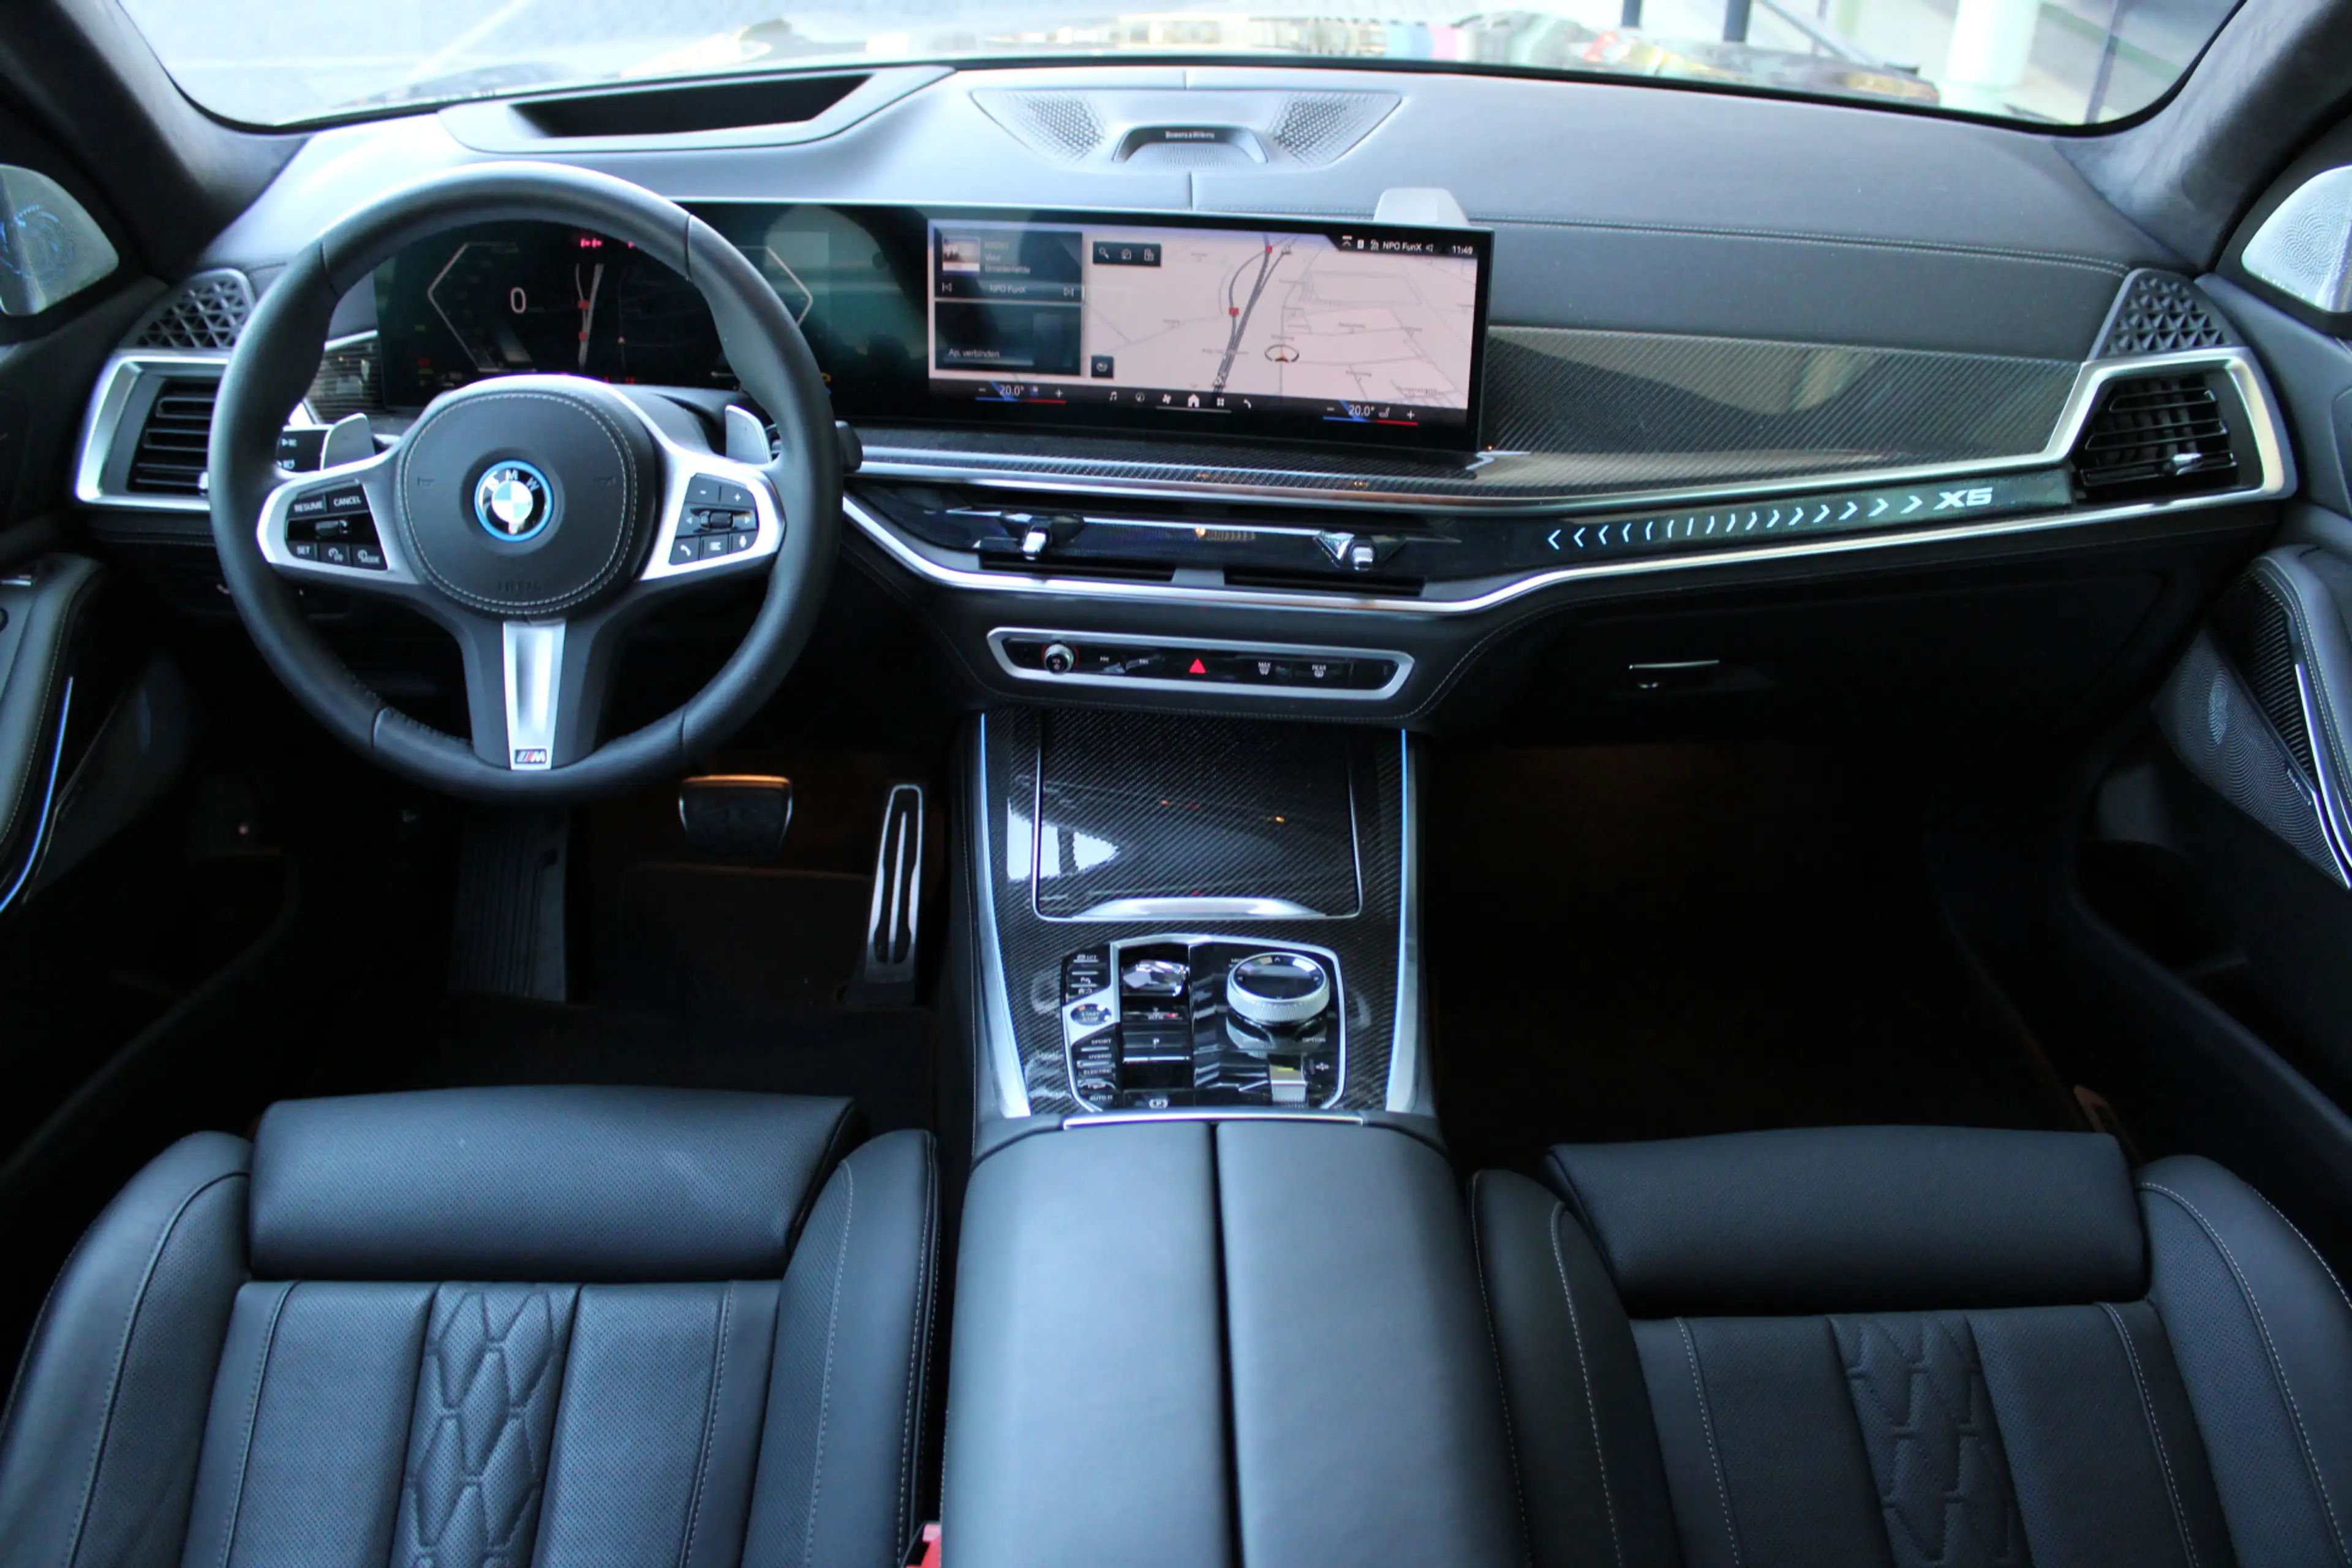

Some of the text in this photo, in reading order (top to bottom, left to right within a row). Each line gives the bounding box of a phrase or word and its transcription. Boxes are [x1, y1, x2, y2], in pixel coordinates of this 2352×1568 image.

[1382, 241, 1400, 251] NPO
[510, 287, 526, 313] 0
[963, 349, 1000, 358] verbinden
[484, 469, 540, 492] BMW
[333, 496, 362, 507] CANCEL
[1933, 486, 1994, 510] X5
[294, 501, 323, 513] RESUME
[296, 546, 311, 556] SET
[360, 556, 380, 564] MODE
